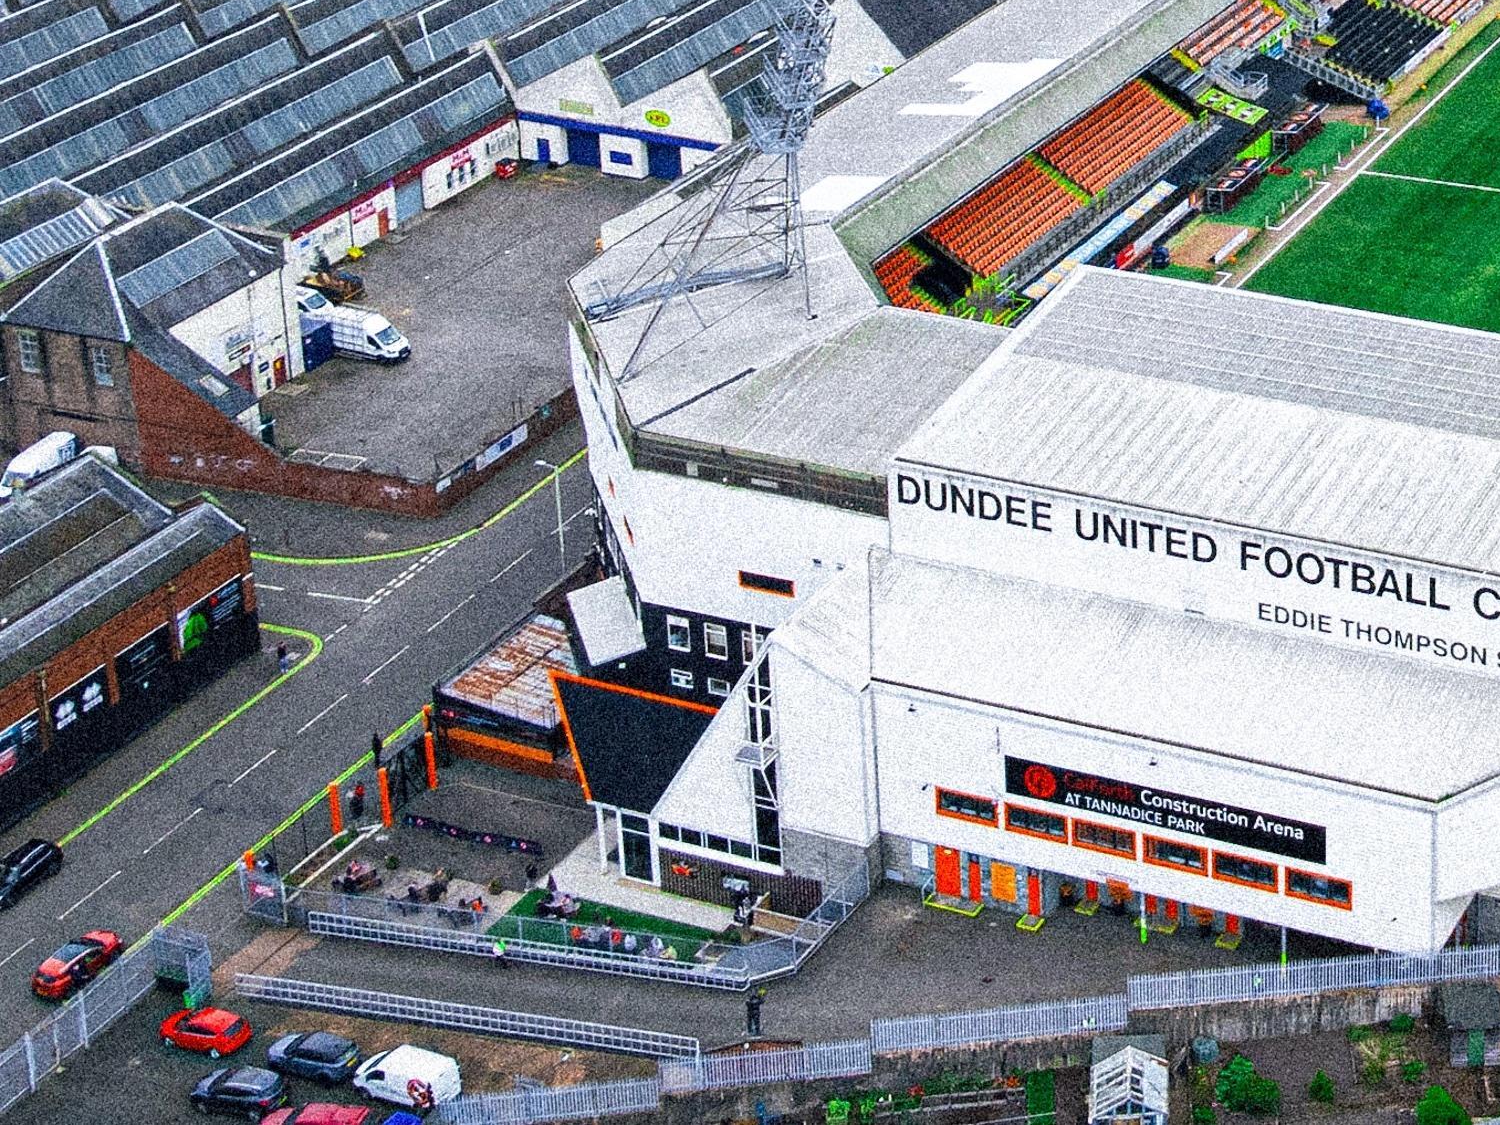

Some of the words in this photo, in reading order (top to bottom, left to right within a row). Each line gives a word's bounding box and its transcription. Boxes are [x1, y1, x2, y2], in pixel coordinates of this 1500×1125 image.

[897, 475, 1053, 532] DUNDEE
[1075, 508, 1218, 564] UNITED
[1240, 540, 1451, 611] FOOTBALL
[1258, 602, 1333, 634] EDDIE
[1340, 619, 1487, 666] THOMPSON
[1064, 792, 1081, 806] AT
[1084, 796, 1162, 824] TANNADICE
[1167, 815, 1206, 835] PARK
[1140, 790, 1249, 828] Construction
[1253, 816, 1305, 841] Arena
